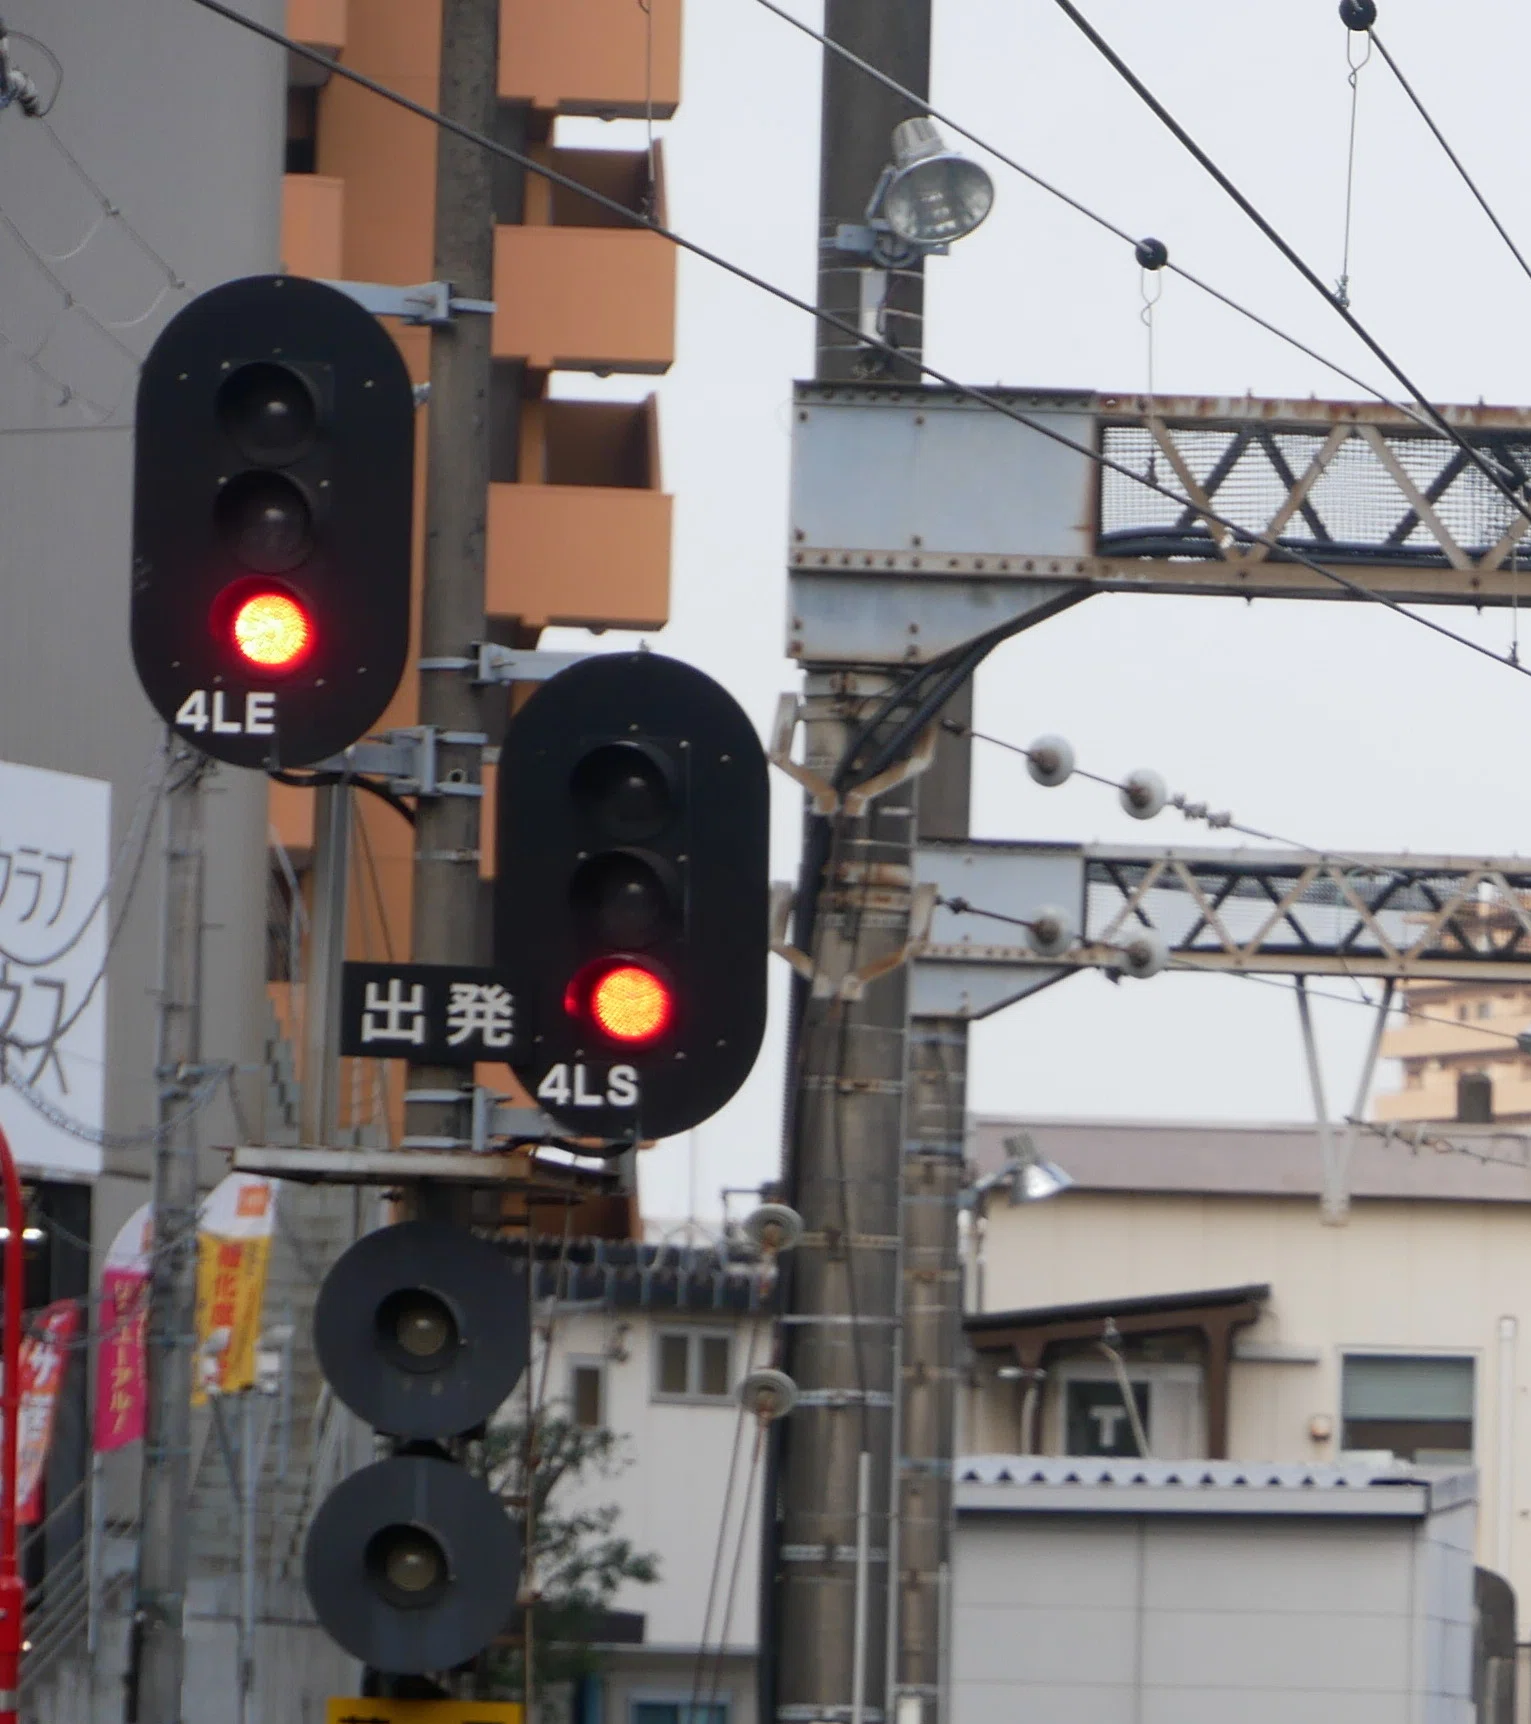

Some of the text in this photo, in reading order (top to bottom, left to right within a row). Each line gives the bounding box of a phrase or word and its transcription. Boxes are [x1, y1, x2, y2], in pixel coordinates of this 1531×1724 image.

[175, 689, 276, 734] 4LE
[361, 977, 516, 1048] 出発
[537, 1062, 641, 1107] 4LS
